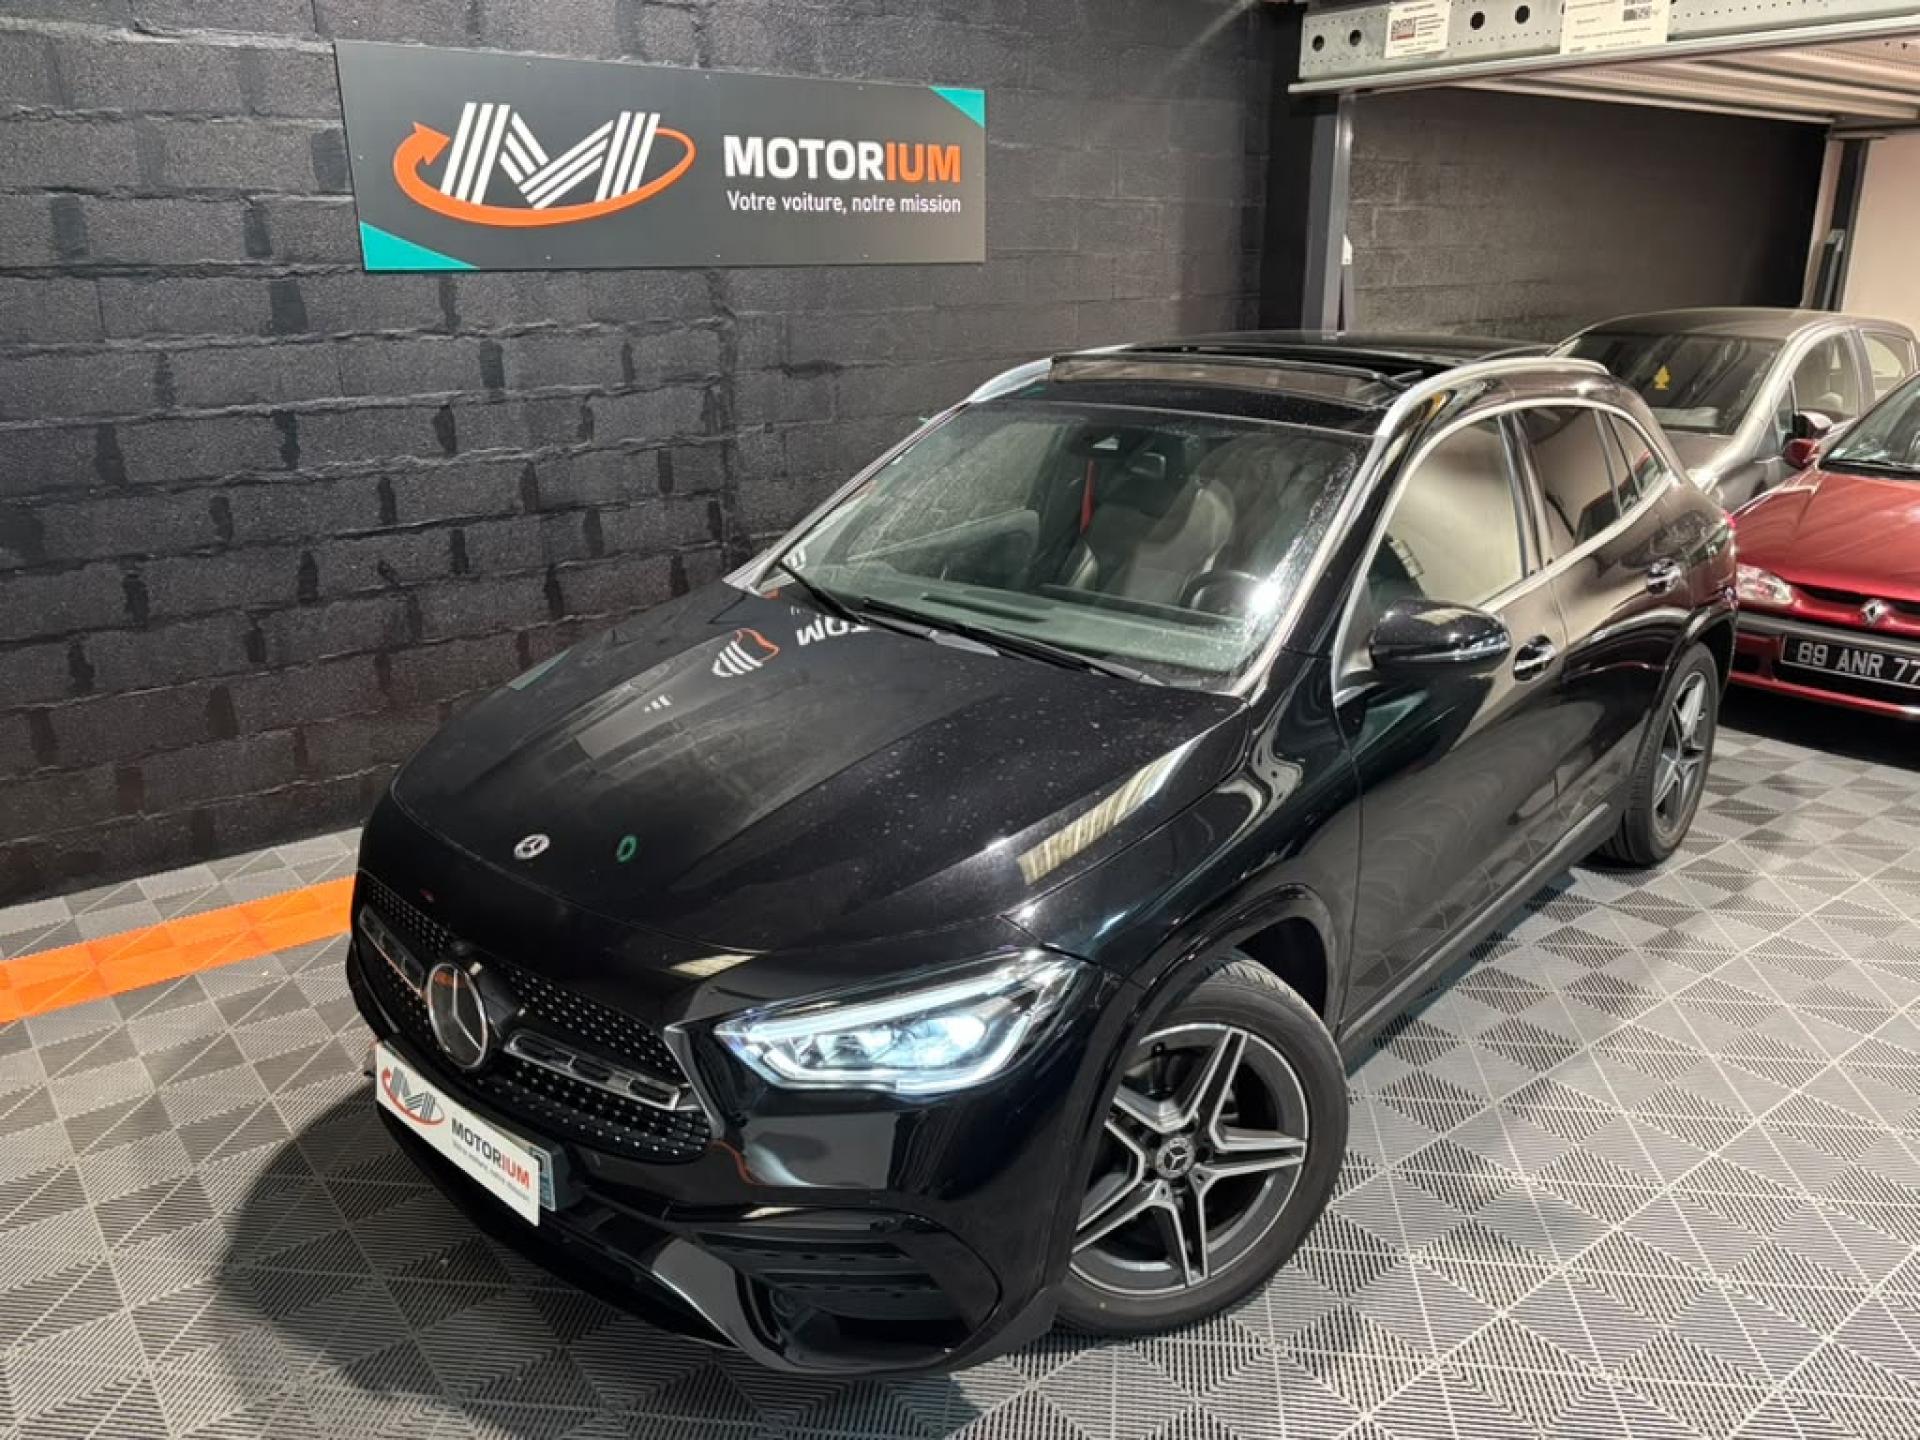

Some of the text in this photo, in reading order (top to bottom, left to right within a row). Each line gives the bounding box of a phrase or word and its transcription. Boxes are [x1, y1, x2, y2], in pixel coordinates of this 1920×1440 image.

[722, 135, 961, 183] MOTORIUM
[726, 190, 961, 214] Votre voiture, notre mission
[1836, 648, 1884, 677] ANR
[451, 1118, 529, 1189] MOTORIUM
